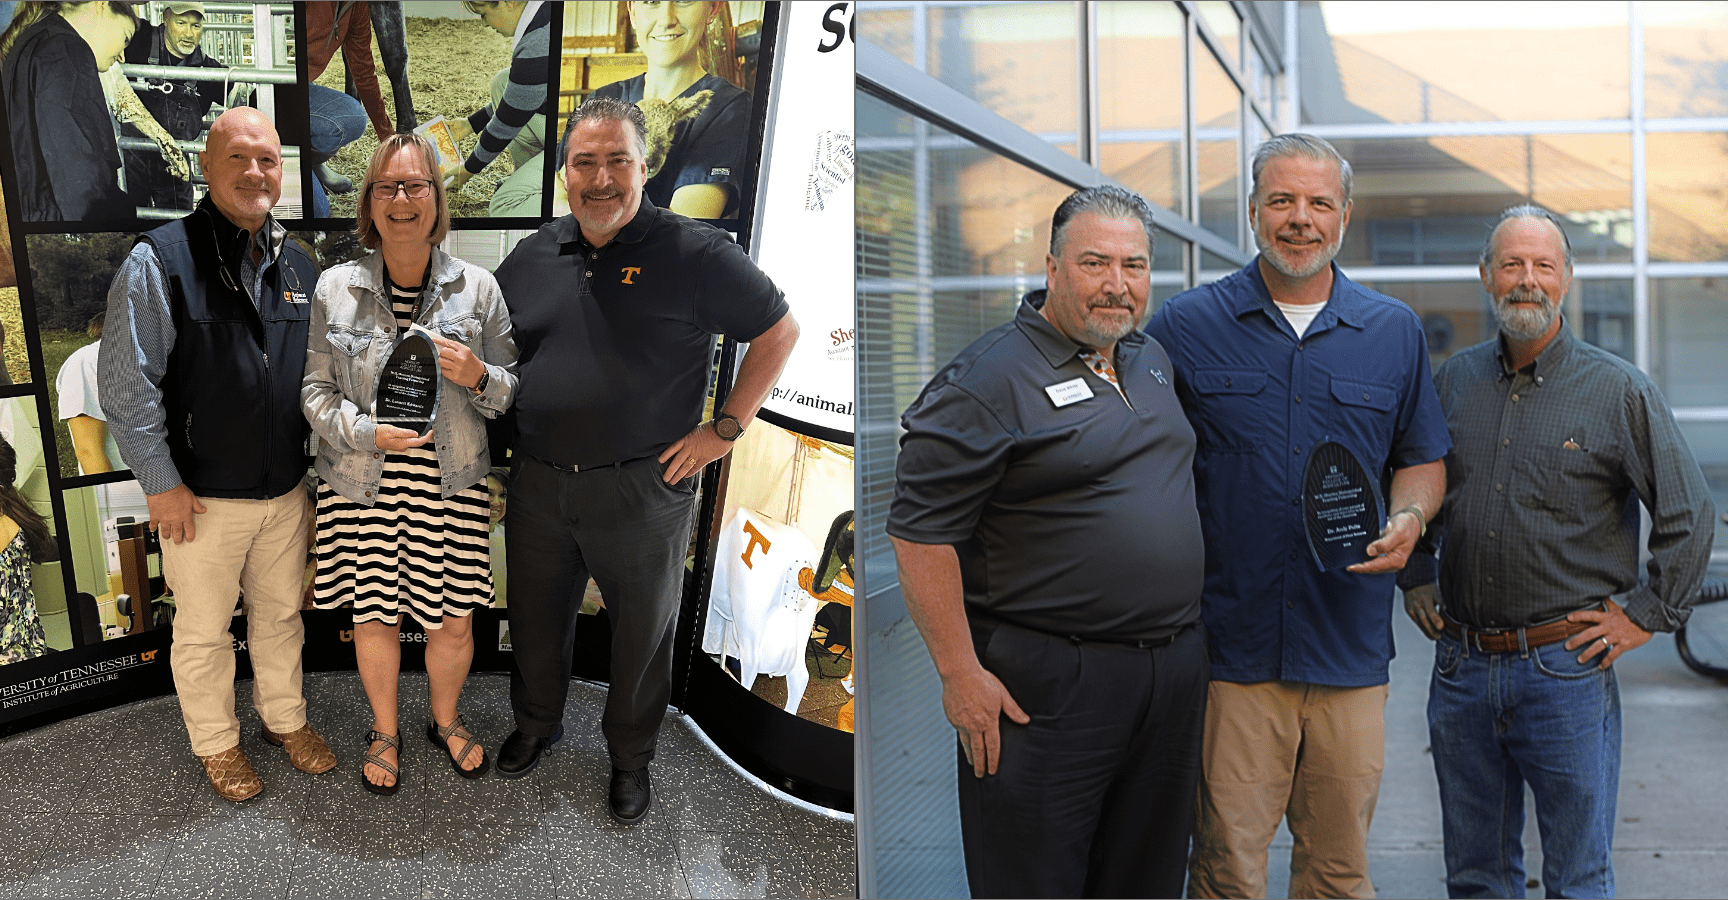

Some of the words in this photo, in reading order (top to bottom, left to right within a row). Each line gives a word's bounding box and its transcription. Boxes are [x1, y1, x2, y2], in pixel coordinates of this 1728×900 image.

[817, 2, 854, 53] S
[821, 161, 846, 184] Scientist
[813, 178, 825, 211] Technician
[621, 266, 641, 285] T
[770, 387, 854, 416] p://animal.
[741, 519, 772, 570] T
[48, 673, 59, 684] of
[60, 654, 138, 682] TENNESSEE
[2, 689, 50, 709] INSTITUTE
[50, 687, 60, 696] of
[59, 673, 119, 694] AGRICULTURE
